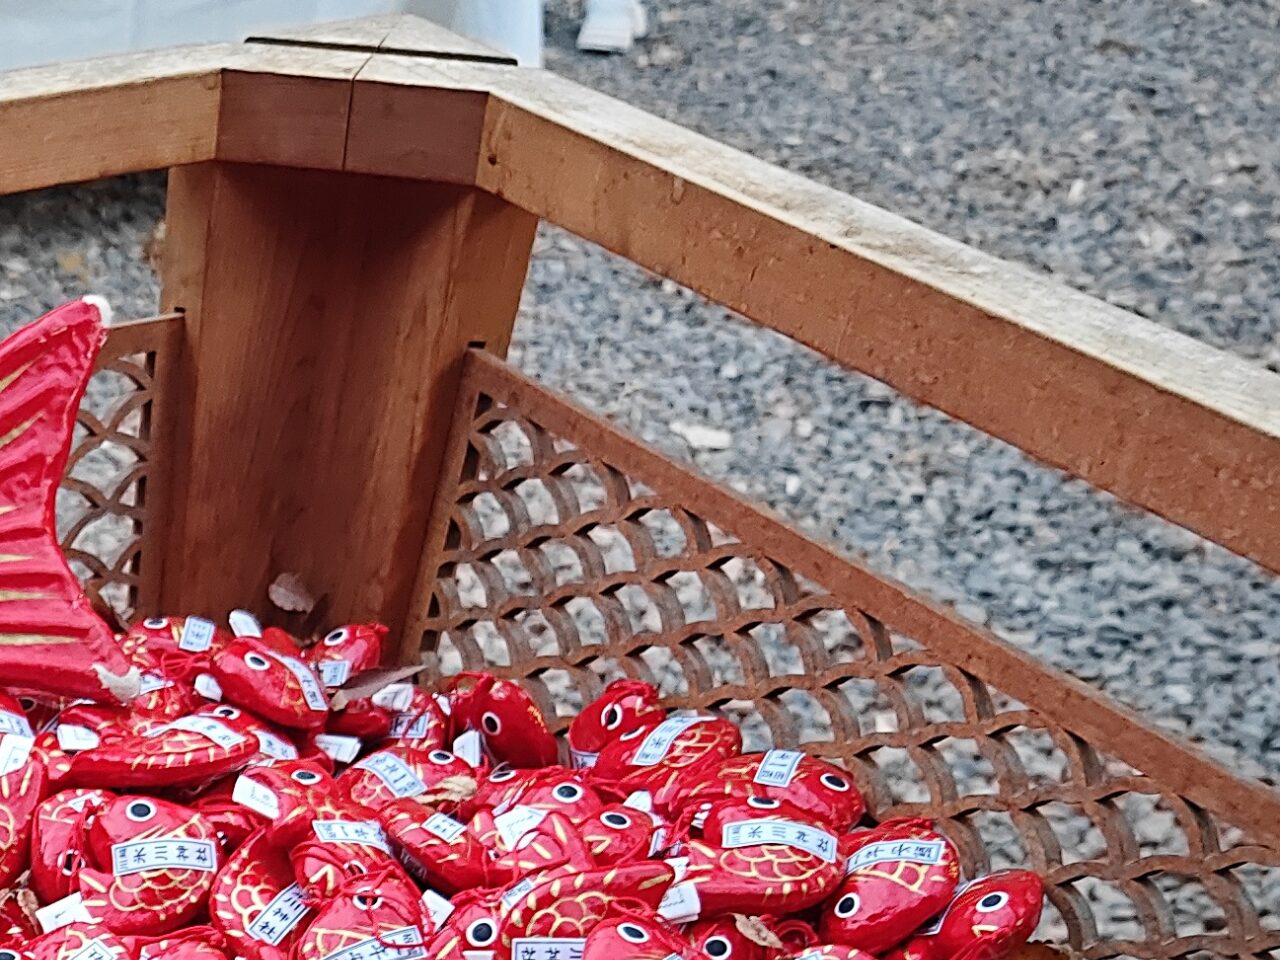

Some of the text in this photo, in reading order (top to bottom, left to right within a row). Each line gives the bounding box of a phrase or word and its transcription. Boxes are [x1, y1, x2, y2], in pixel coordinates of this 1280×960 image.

[134, 844, 208, 863] 氷川神社
[259, 892, 302, 939] 川神社
